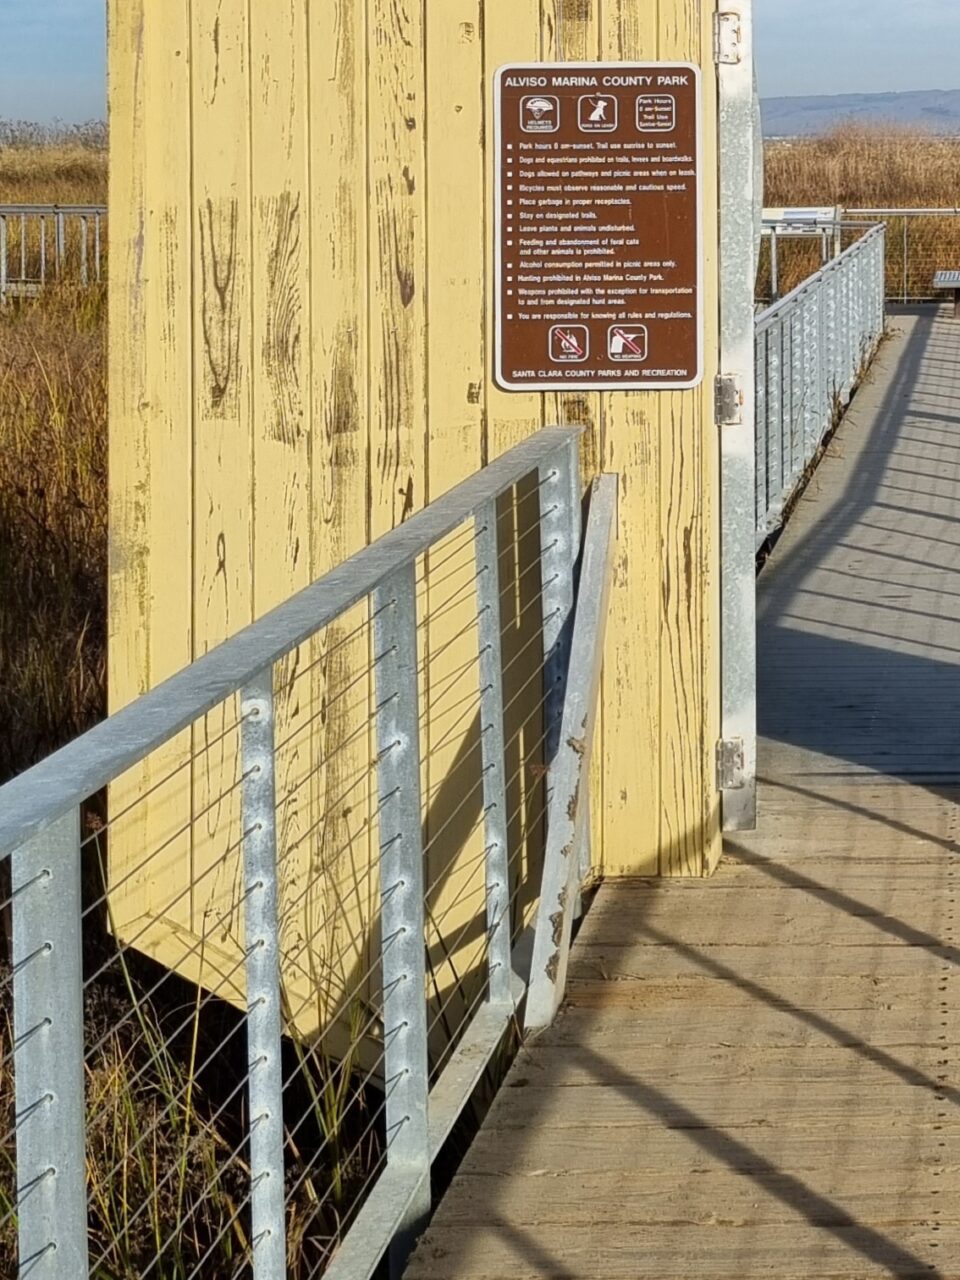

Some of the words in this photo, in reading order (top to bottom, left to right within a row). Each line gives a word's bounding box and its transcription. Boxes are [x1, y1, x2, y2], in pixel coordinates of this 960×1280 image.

[505, 77, 547, 86] ALVISO
[552, 77, 598, 86] MARINA
[603, 76, 651, 86] COUNTY
[657, 76, 688, 85] PARK
[519, 156, 533, 164] Dogs
[519, 170, 535, 178] Dogs
[571, 170, 599, 178] pathways
[519, 212, 534, 220] Stay
[546, 212, 579, 220] designated
[519, 239, 543, 247] Feeding
[662, 260, 677, 268] only.
[518, 275, 541, 283] Hunting
[543, 274, 573, 282] prohibited
[548, 288, 579, 296] prohibited
[557, 298, 590, 306] designated
[543, 312, 578, 320] responsible
[591, 312, 616, 320] knowing
